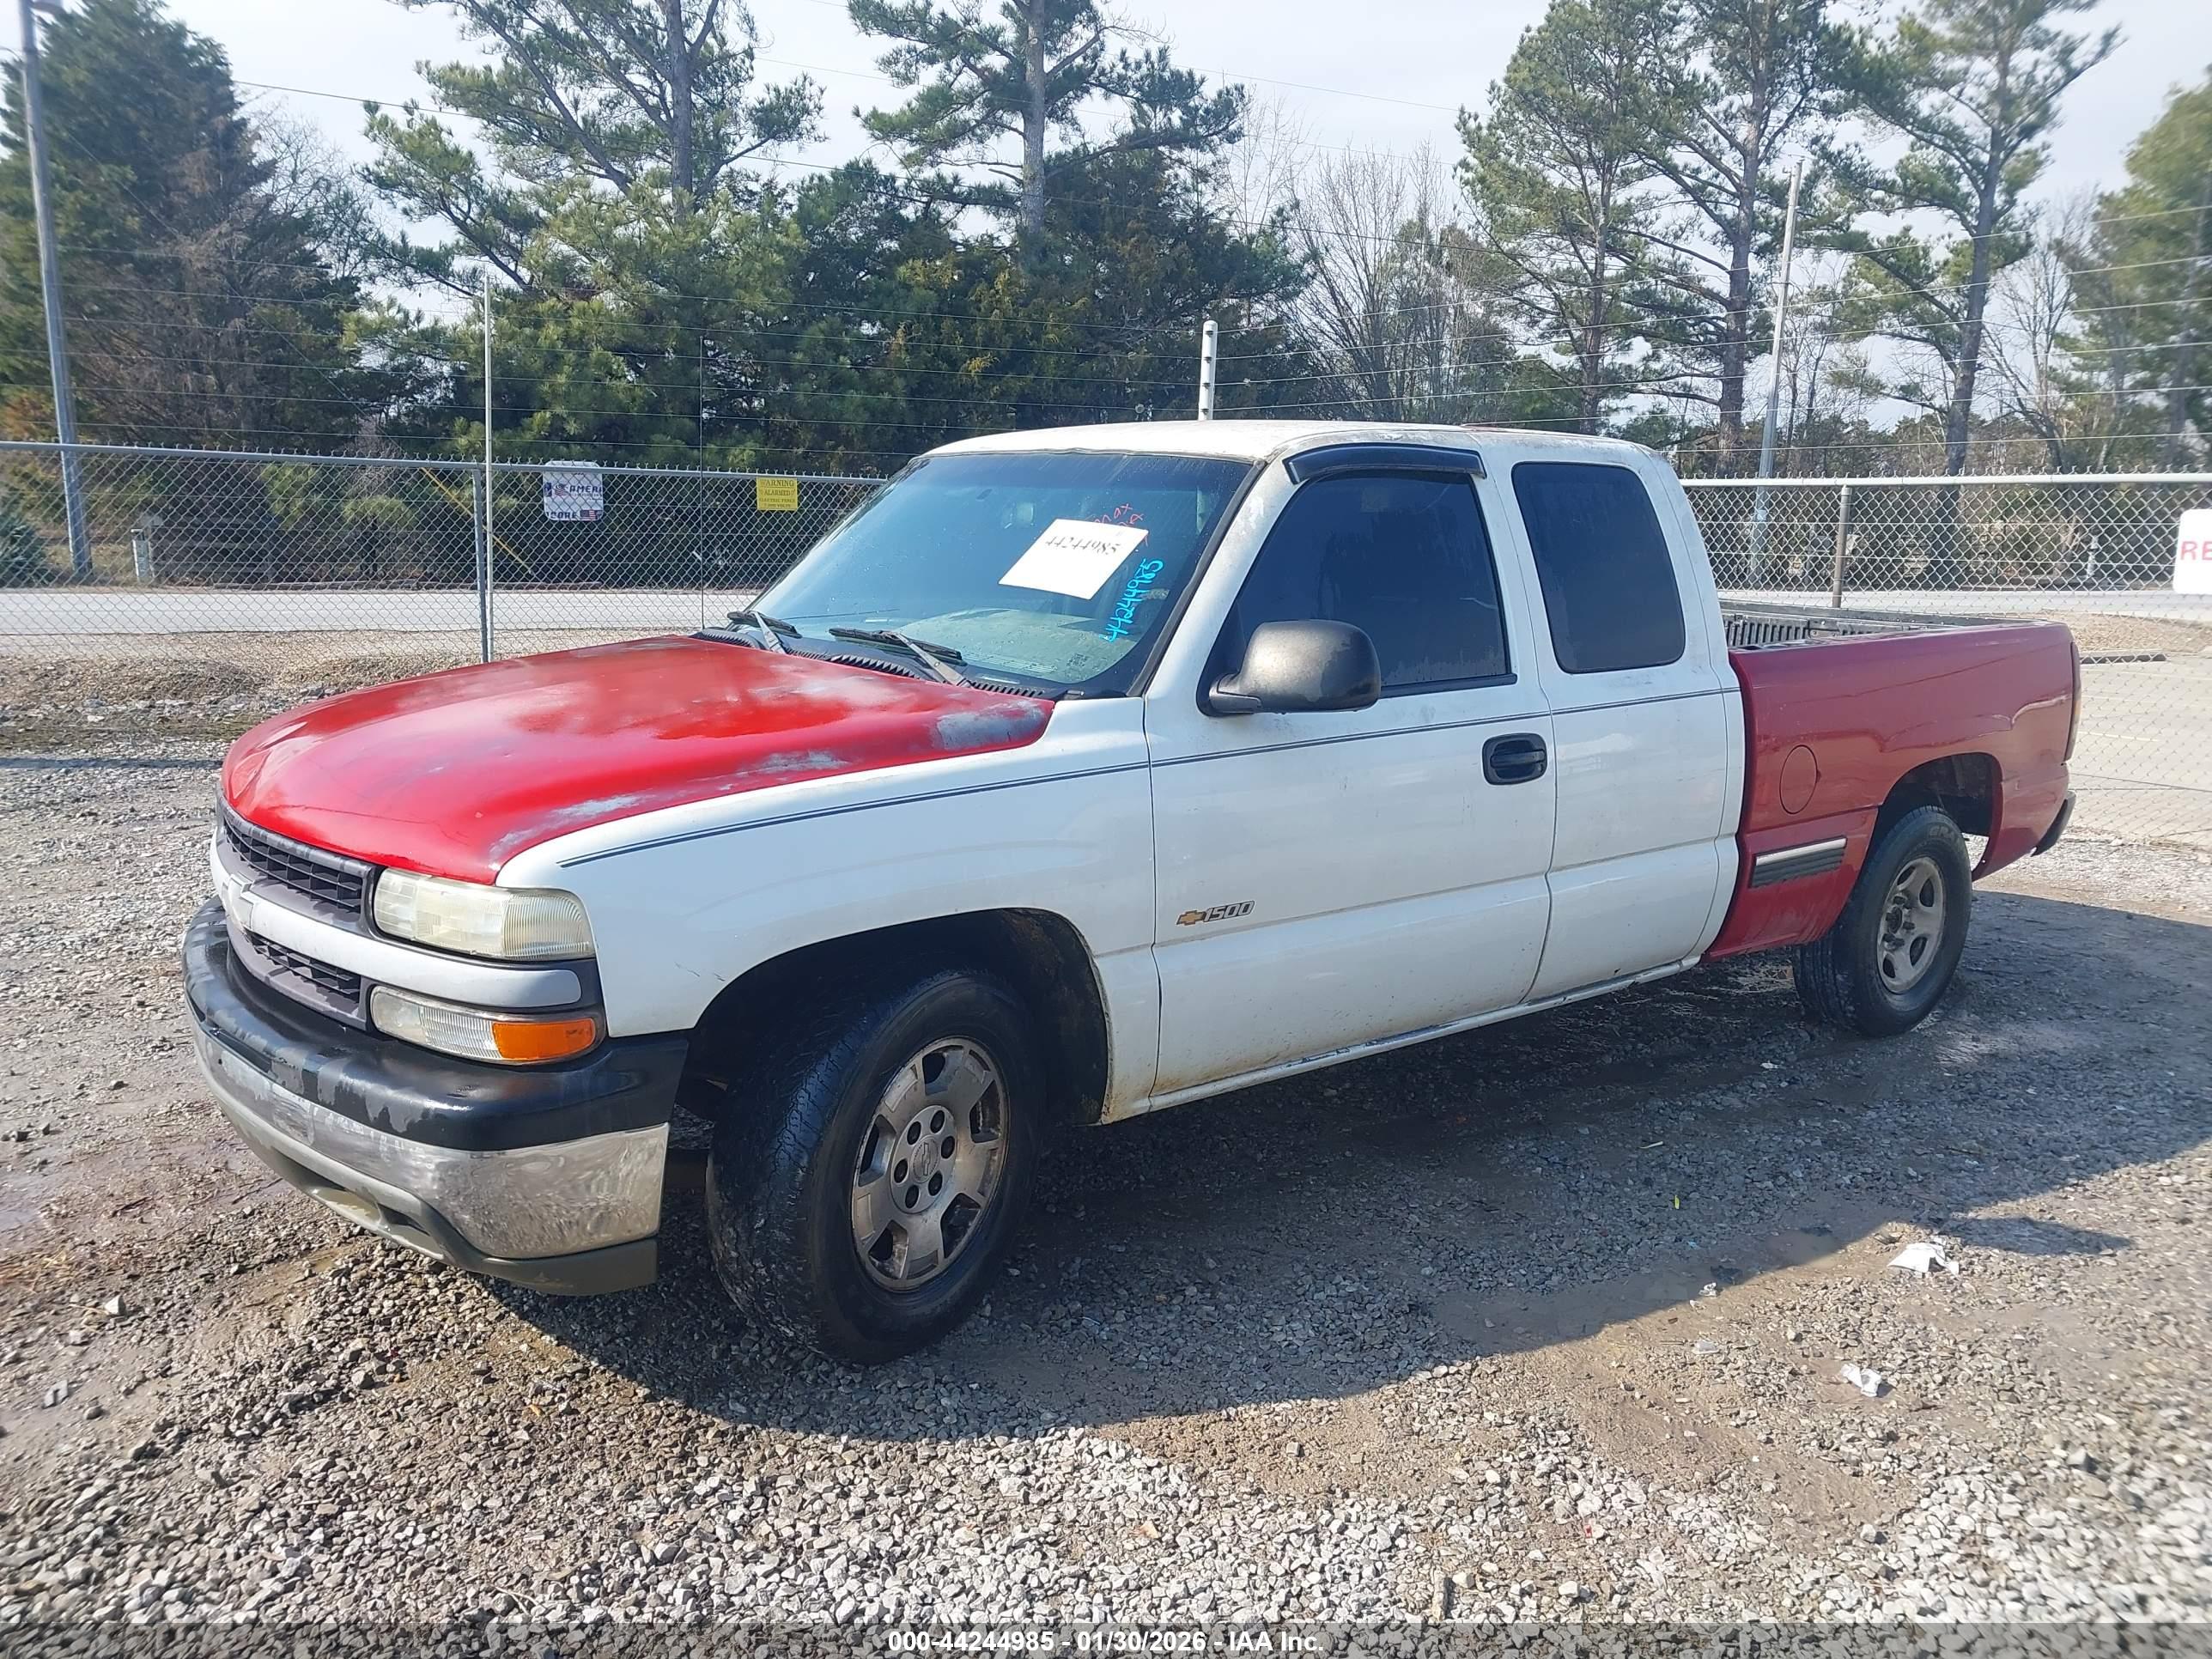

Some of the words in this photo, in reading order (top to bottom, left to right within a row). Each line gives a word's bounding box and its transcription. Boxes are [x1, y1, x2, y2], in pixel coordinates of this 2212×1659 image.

[1045, 536, 1121, 555] 44244985
[1098, 557, 1164, 643] 44244985
[1203, 901, 1255, 922] 1500
